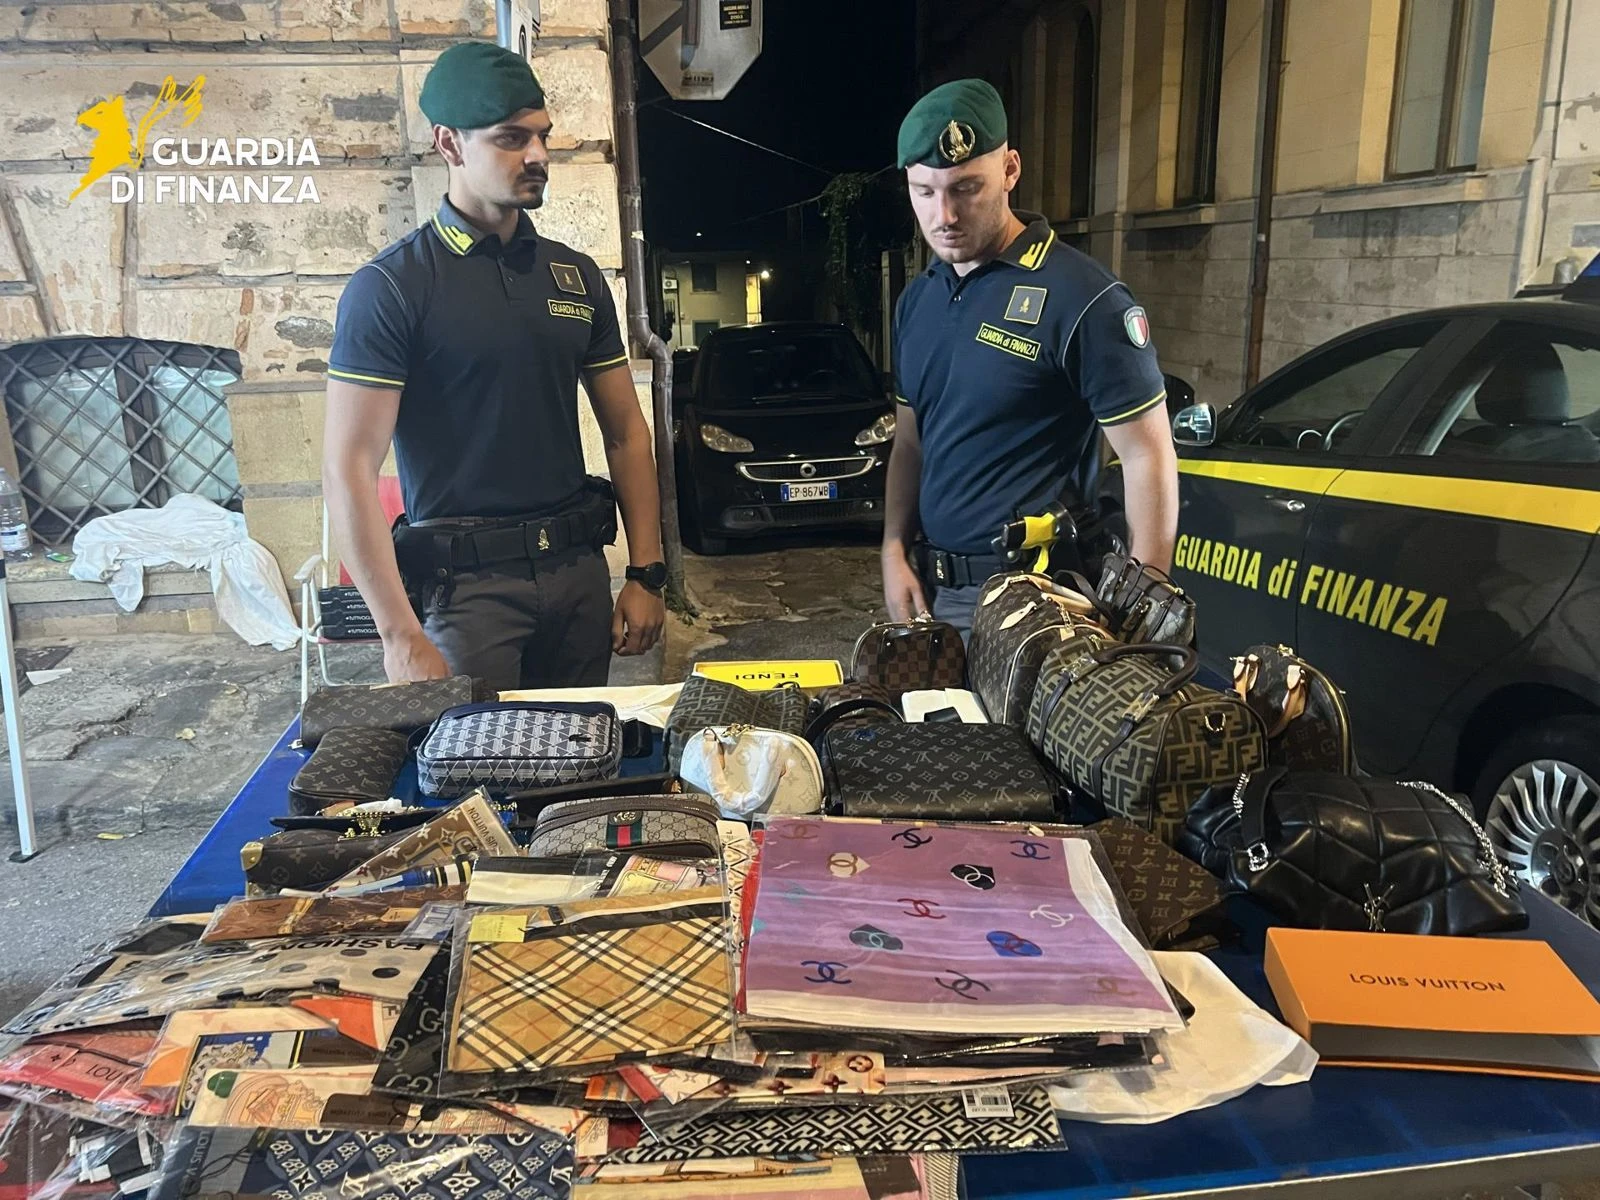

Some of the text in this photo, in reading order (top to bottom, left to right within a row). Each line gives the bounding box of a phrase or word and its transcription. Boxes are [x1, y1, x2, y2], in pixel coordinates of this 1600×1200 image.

[551, 303, 576, 315] GUARDIA
[980, 328, 1036, 356] GUARDIA di FINANZA
[1174, 533, 1448, 647] GUARDIA di FINANZA
[735, 671, 800, 681] FENDI
[1349, 973, 1507, 992] LOUIS VUITTON
